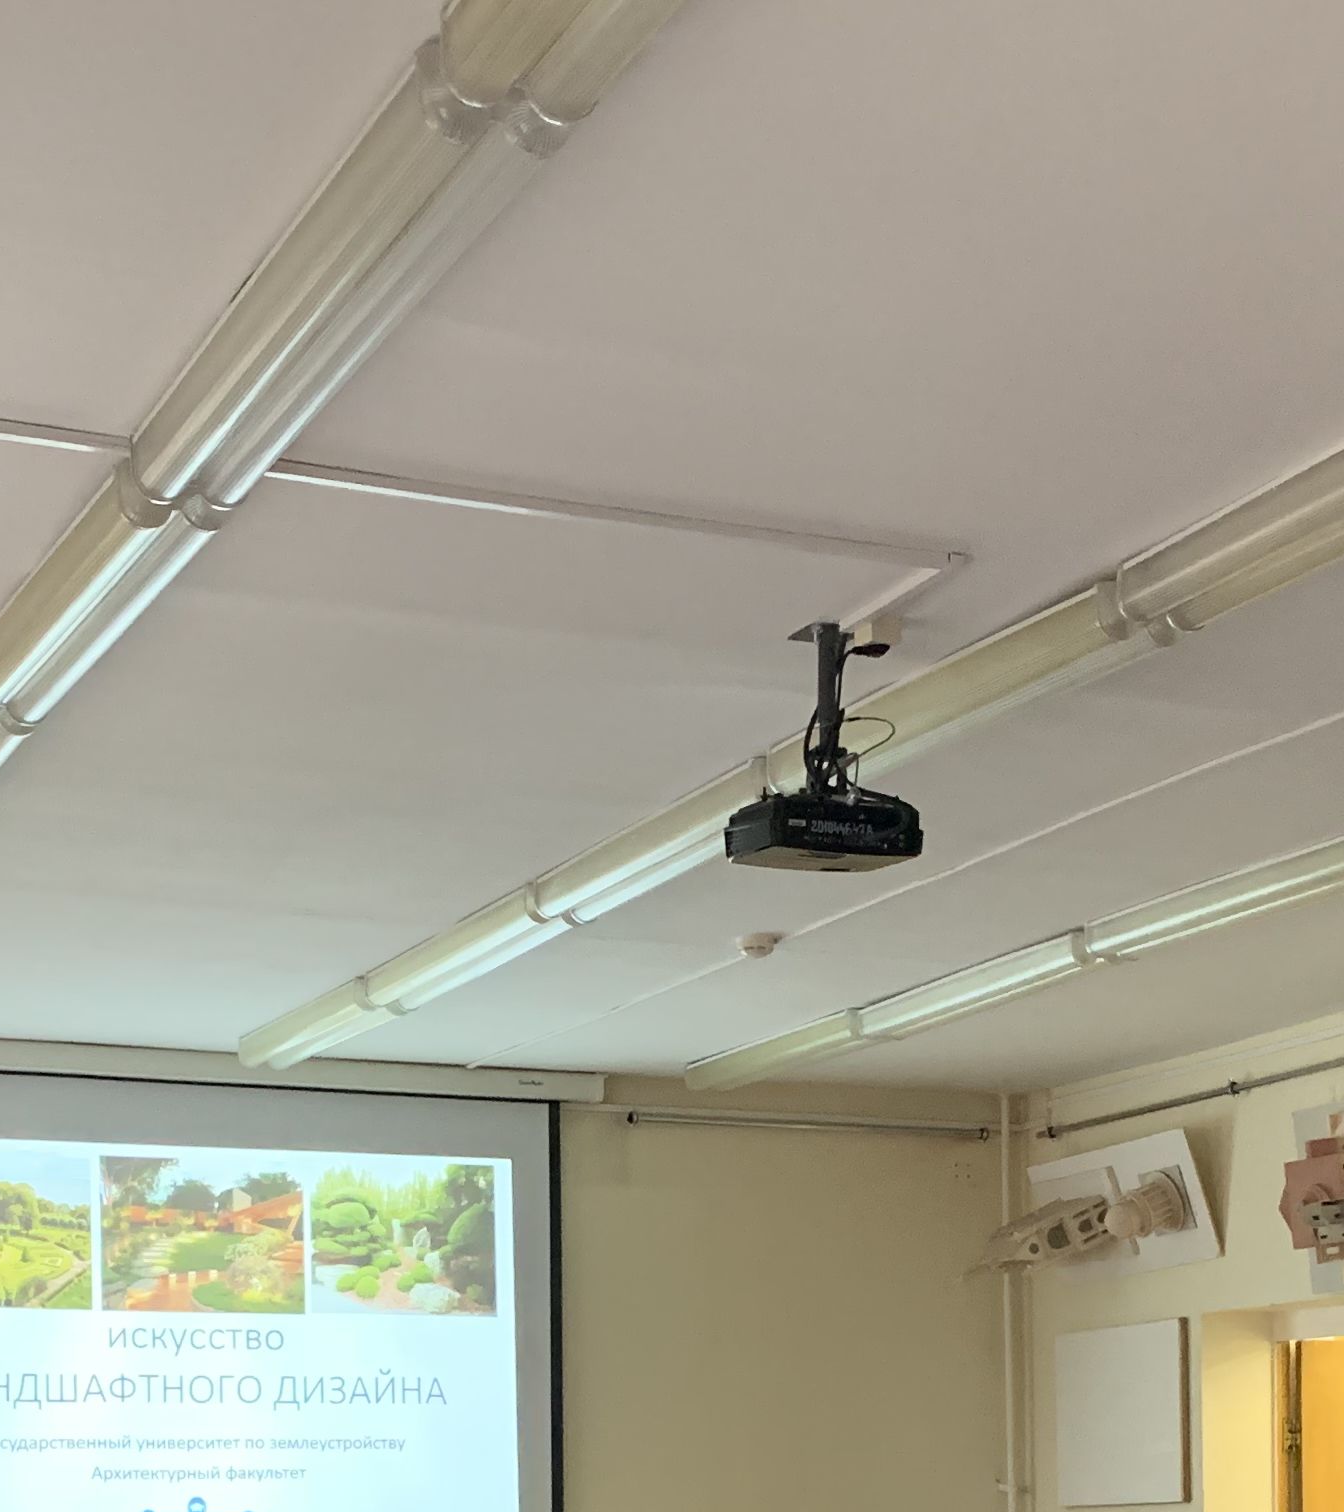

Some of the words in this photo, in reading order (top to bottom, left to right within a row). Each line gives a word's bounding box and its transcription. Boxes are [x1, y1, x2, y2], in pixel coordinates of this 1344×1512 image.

[273, 1368, 447, 1411] ДИЗАЙНА
[136, 1437, 240, 1453] университет
[245, 1438, 264, 1450] по
[270, 1435, 406, 1453] землеустройству
[91, 1465, 220, 1483] Архитектурный
[226, 1465, 307, 1483] факультет
